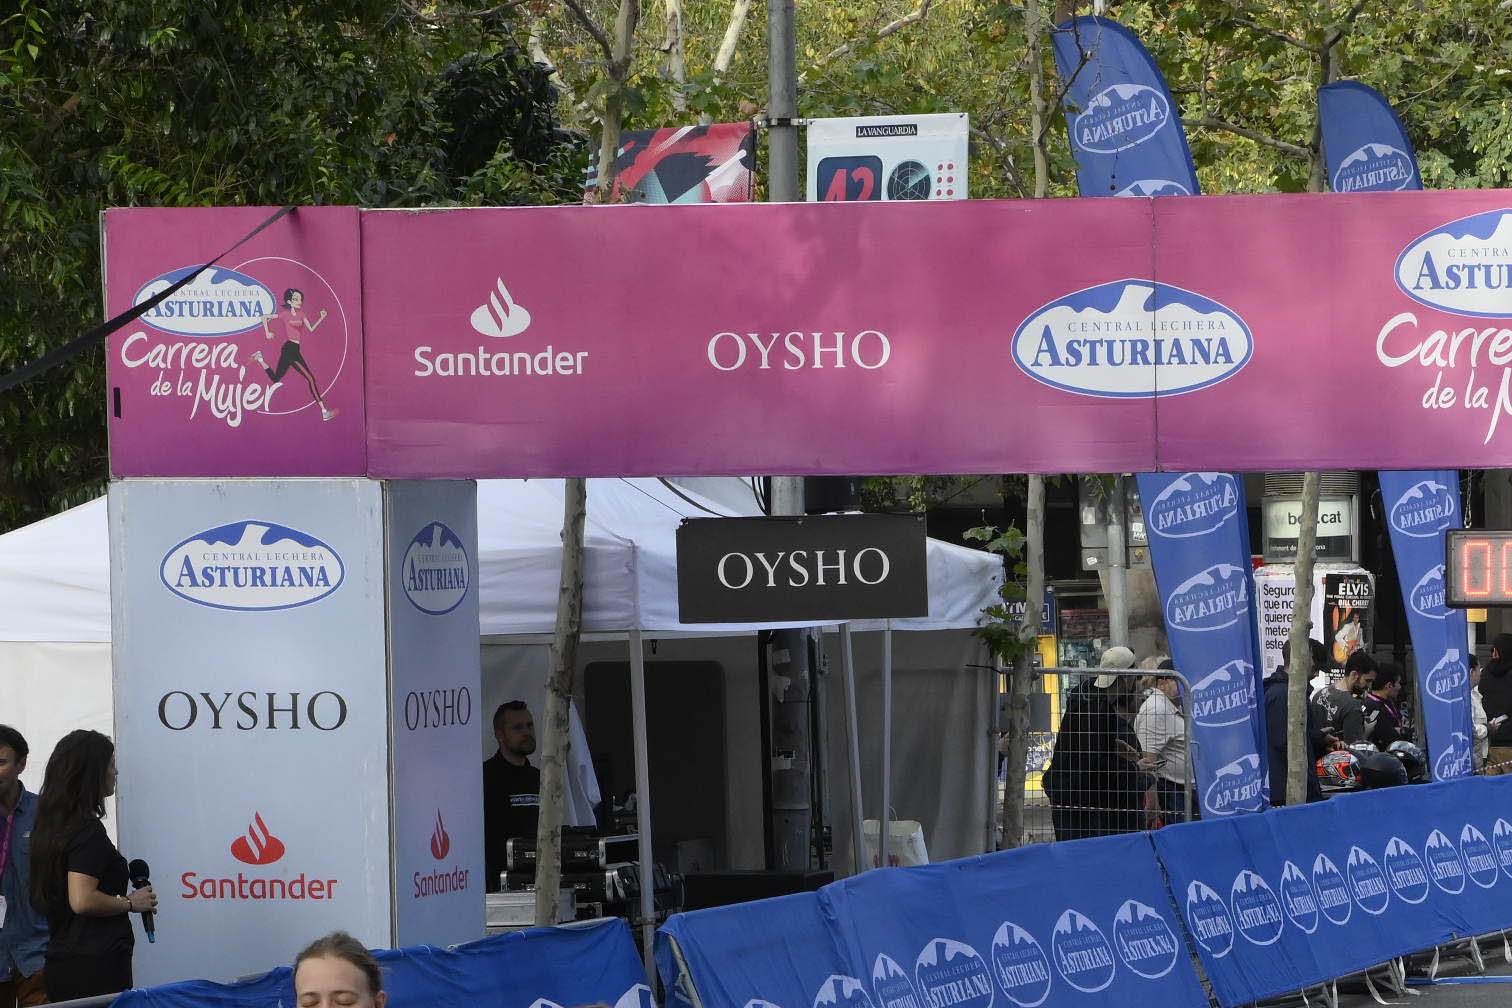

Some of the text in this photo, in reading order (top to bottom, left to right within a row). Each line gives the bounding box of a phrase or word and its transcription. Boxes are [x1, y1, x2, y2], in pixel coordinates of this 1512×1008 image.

[867, 126, 917, 136] VANGUARDIA
[144, 291, 265, 318] ASTURIANA
[1067, 319, 1227, 333] CENTRAL LECHERA
[121, 331, 239, 370] Carrera
[414, 345, 588, 377] Santander
[707, 330, 891, 371] OYSHO
[1030, 324, 1235, 367] ASTURIANA
[150, 366, 284, 428] de la Mujer
[1422, 371, 1456, 410] de
[1464, 370, 1488, 409] la
[174, 554, 331, 588] ASTURIANA
[203, 552, 325, 562] CENTRAL LECHERA
[408, 556, 465, 592] ASTURIANA
[717, 547, 890, 589] OYSHO
[1264, 599, 1280, 611] que
[1338, 582, 1369, 596] ELVIS
[157, 690, 347, 731] OYSHO
[405, 686, 472, 731] OYSHO
[181, 872, 337, 900] Santander
[413, 865, 469, 900] Santander
[996, 958, 1049, 989] ASTURIANA
[1057, 943, 1112, 975] ASTURIANA
